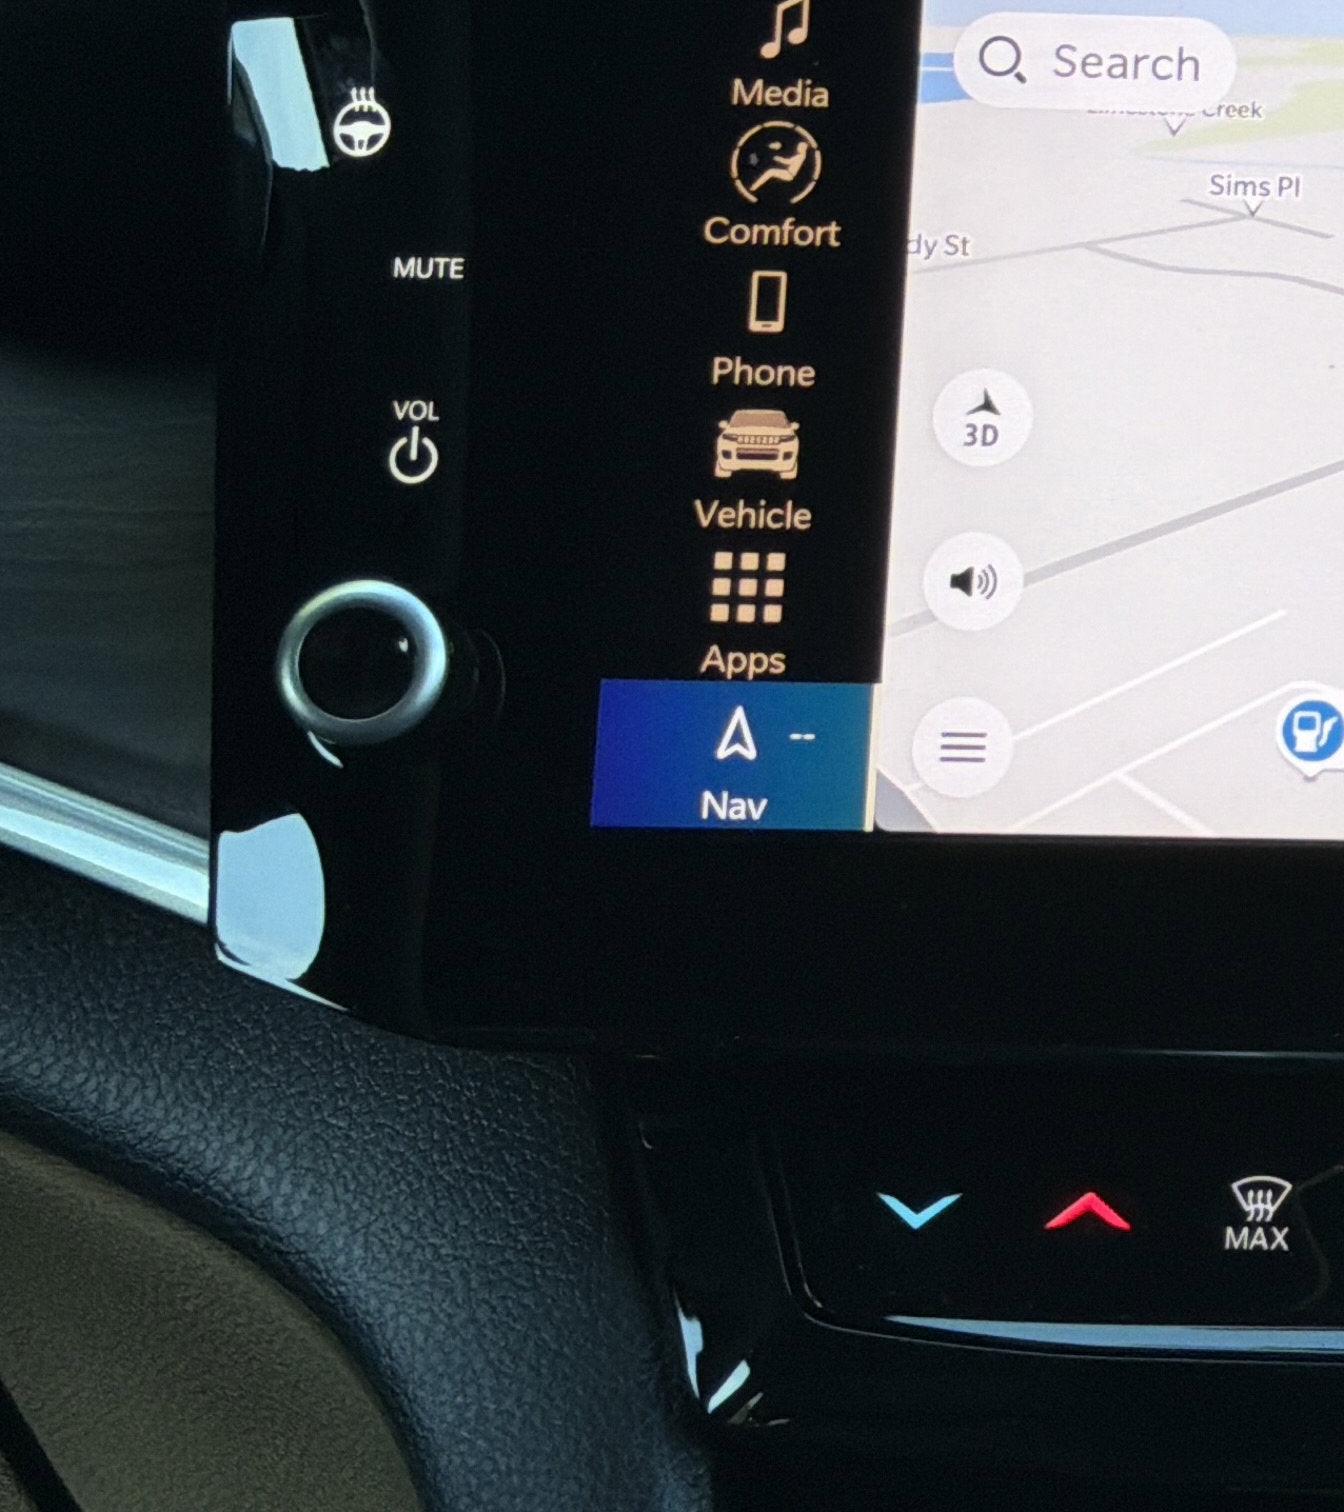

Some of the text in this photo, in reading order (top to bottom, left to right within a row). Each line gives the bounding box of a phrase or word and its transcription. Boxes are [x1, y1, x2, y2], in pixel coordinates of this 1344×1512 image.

[1053, 44, 1200, 83] Search
[731, 79, 829, 108] Media
[1210, 175, 1299, 198] Sims Pl
[704, 217, 841, 248] Comfort
[944, 234, 970, 256] St
[393, 257, 464, 279] MUTE
[712, 357, 815, 387] Phone
[393, 401, 439, 422] VOL
[962, 423, 999, 448] 3D
[694, 498, 812, 530] Vehicle
[699, 644, 786, 680] Apps
[701, 792, 768, 821] Nav
[1224, 1226, 1290, 1252] MAX
